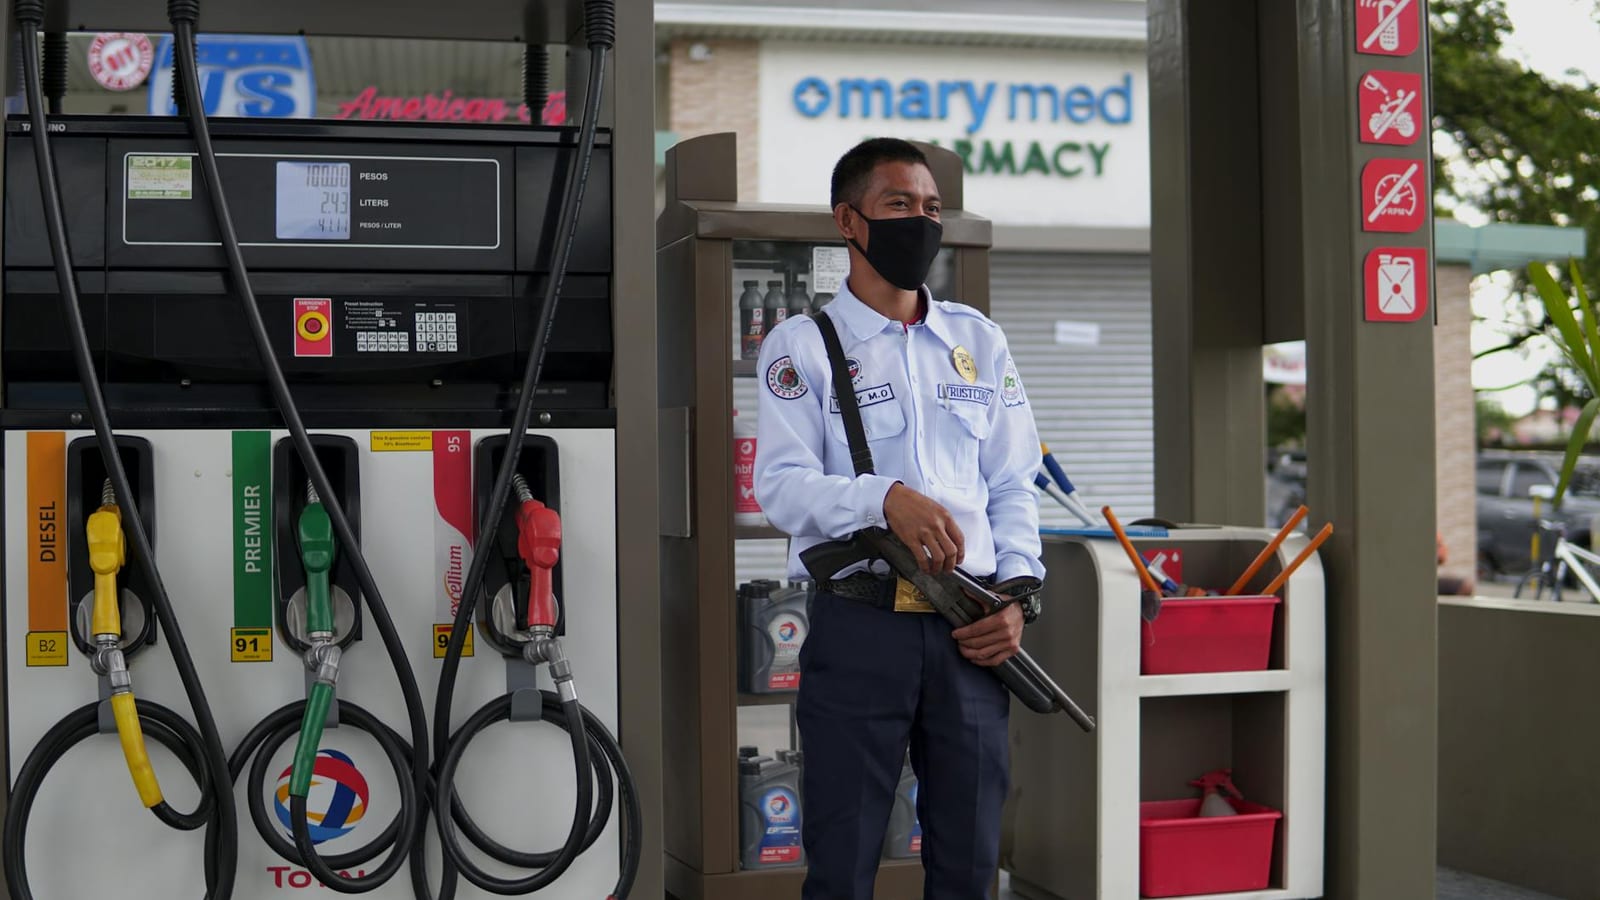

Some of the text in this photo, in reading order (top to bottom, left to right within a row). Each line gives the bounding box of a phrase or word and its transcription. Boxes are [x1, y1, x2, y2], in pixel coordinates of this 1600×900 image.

[335, 86, 508, 121] American
[839, 74, 1133, 133] mary med
[360, 172, 388, 181] PESOS
[360, 199, 389, 207] LITERS
[448, 435, 461, 452] 95
[40, 501, 56, 562] DIESEL
[244, 485, 261, 573] PREMIER
[448, 545, 462, 617] excellium
[39, 640, 56, 652] B2
[236, 638, 258, 652] 91
[437, 634, 451, 648] 9
